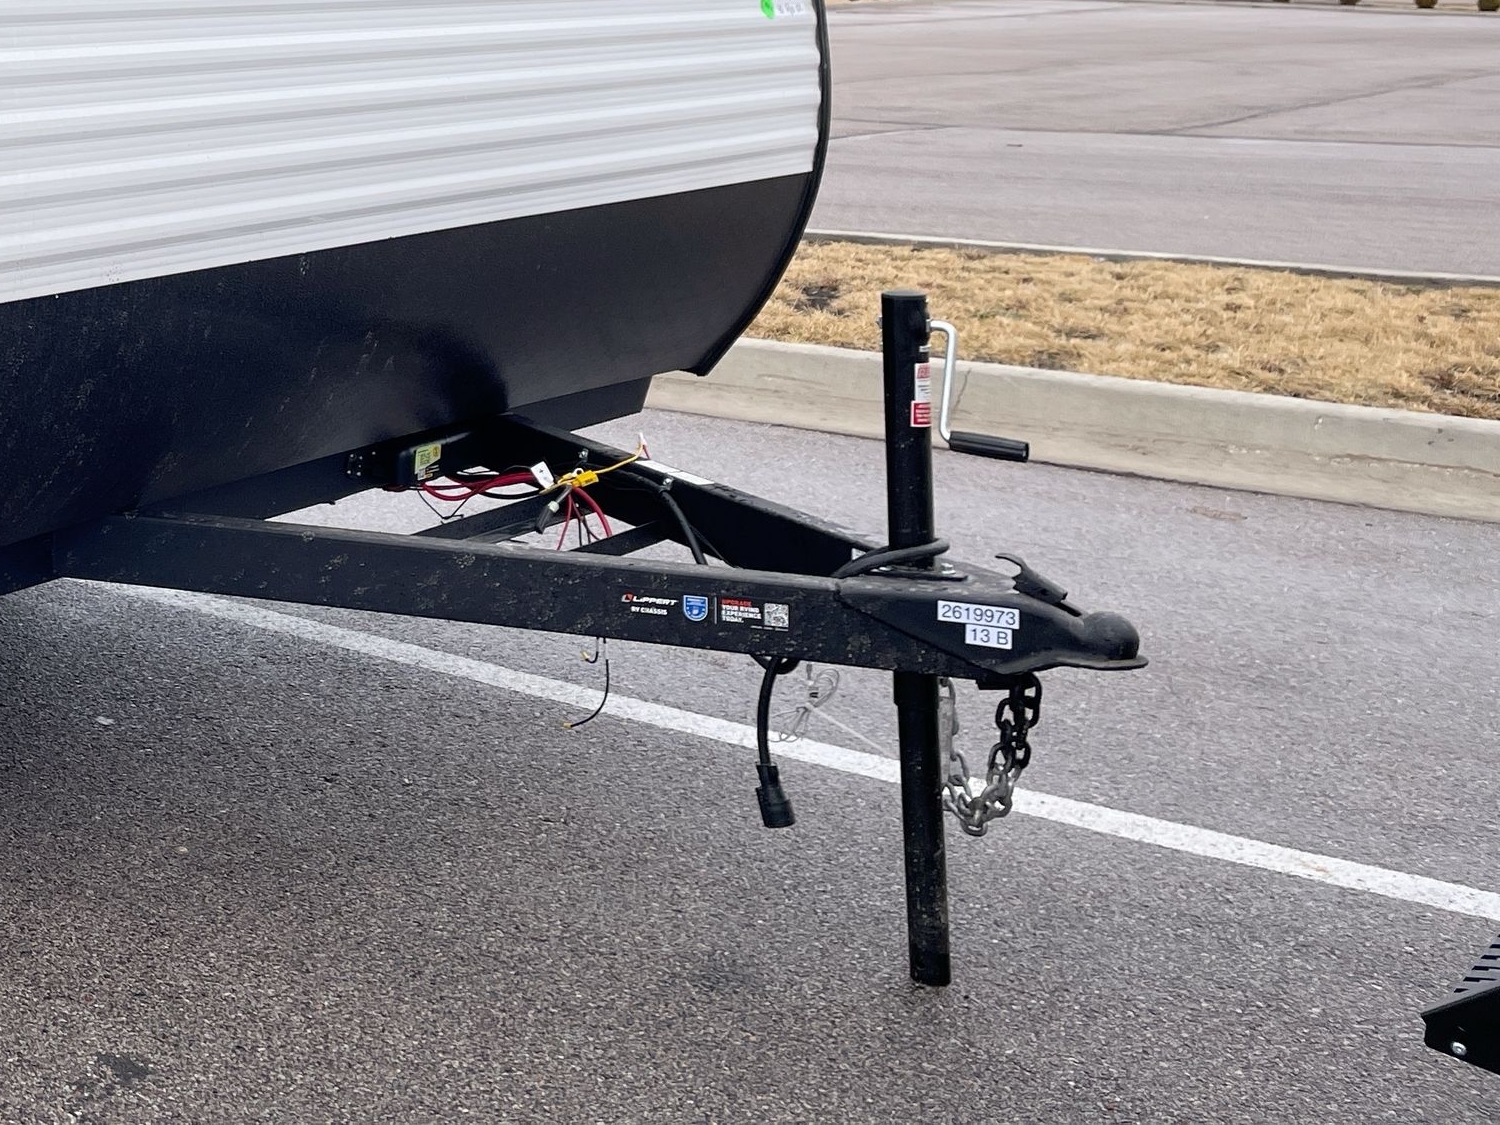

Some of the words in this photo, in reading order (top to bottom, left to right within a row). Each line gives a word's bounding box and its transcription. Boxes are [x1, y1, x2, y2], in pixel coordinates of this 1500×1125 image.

[632, 595, 679, 606] LIPPERT
[640, 607, 668, 616] CHASSIS
[941, 604, 1016, 626] 2619973
[971, 628, 990, 643] 13
[996, 631, 1009, 645] B
